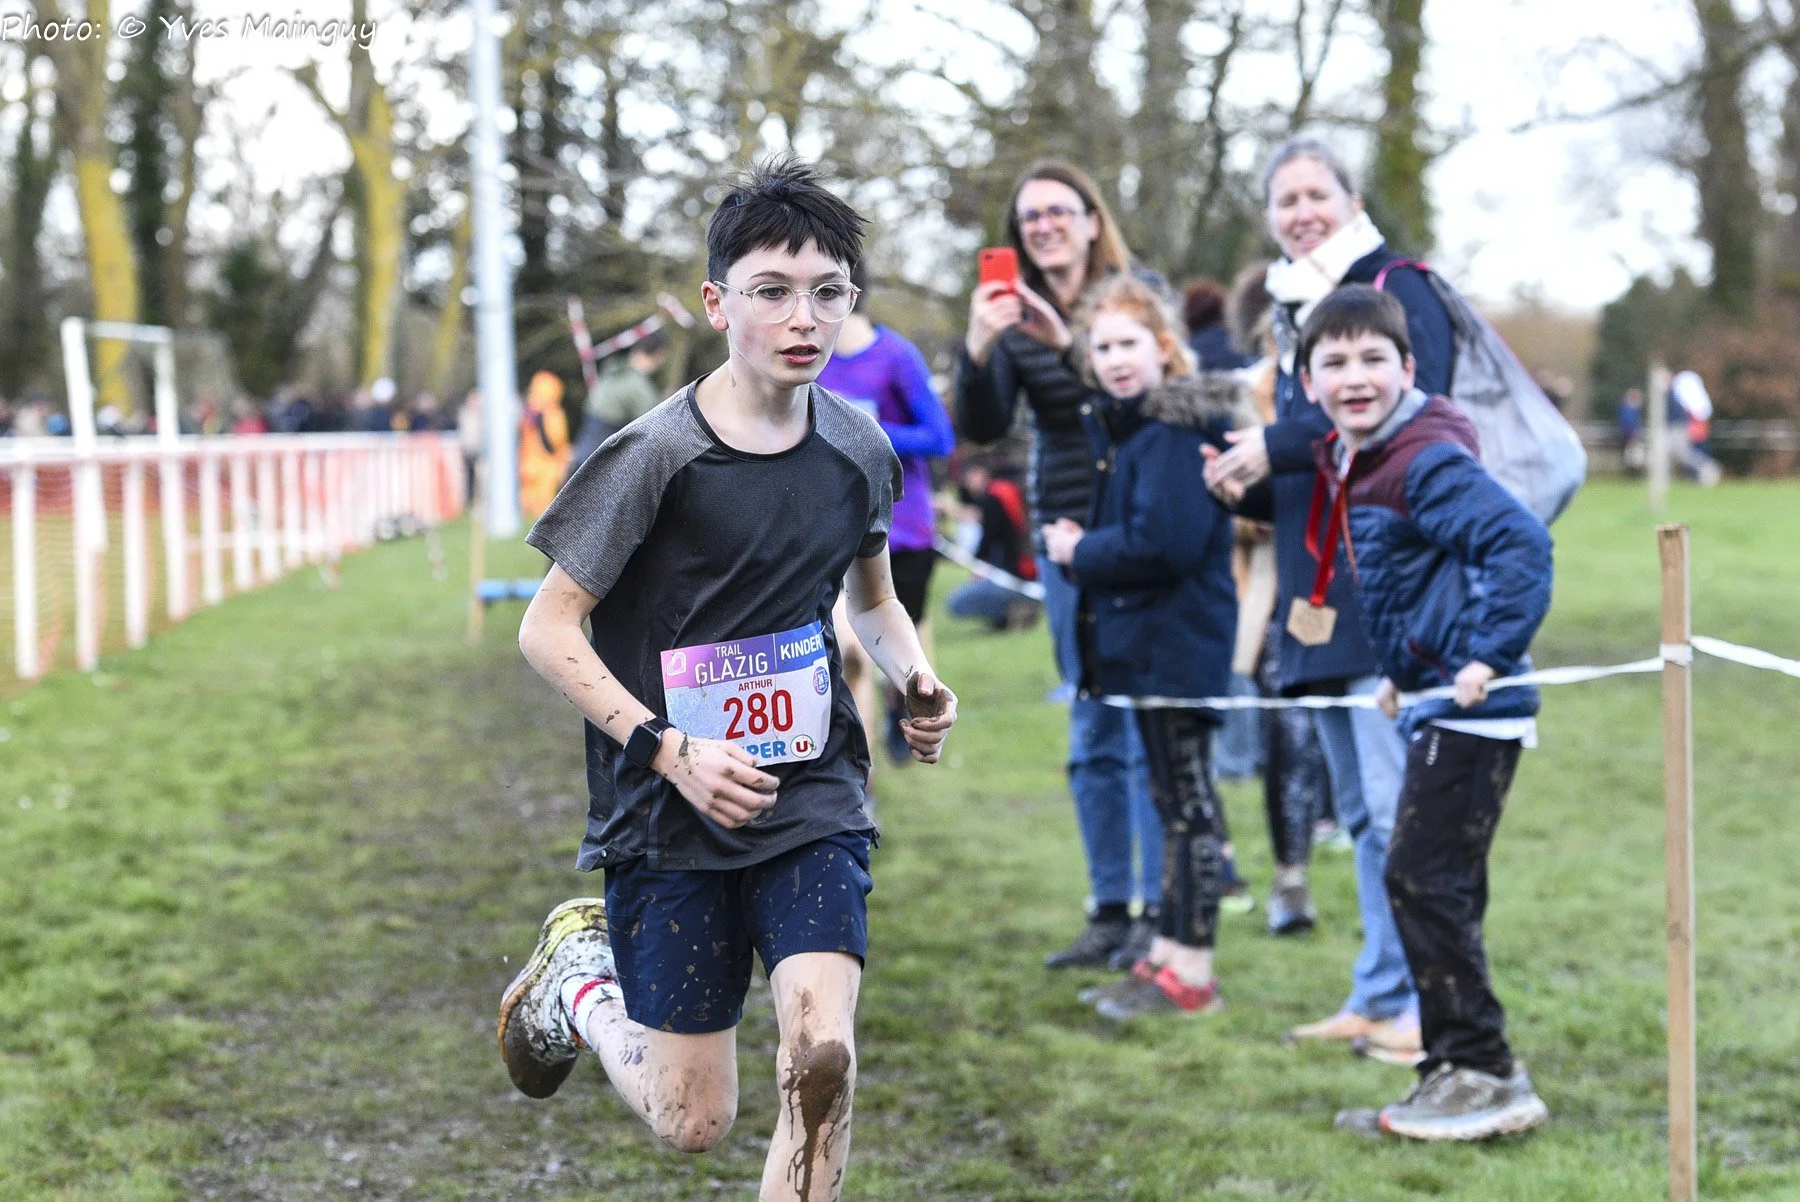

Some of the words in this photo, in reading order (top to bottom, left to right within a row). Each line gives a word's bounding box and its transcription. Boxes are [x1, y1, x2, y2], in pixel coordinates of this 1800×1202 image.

[715, 644, 742, 657] TRAIL
[780, 634, 823, 660] KINDER
[695, 653, 768, 684] GLAZIG
[738, 678, 773, 692] ARTHUR
[723, 689, 794, 741] 280
[746, 740, 787, 759] PER
